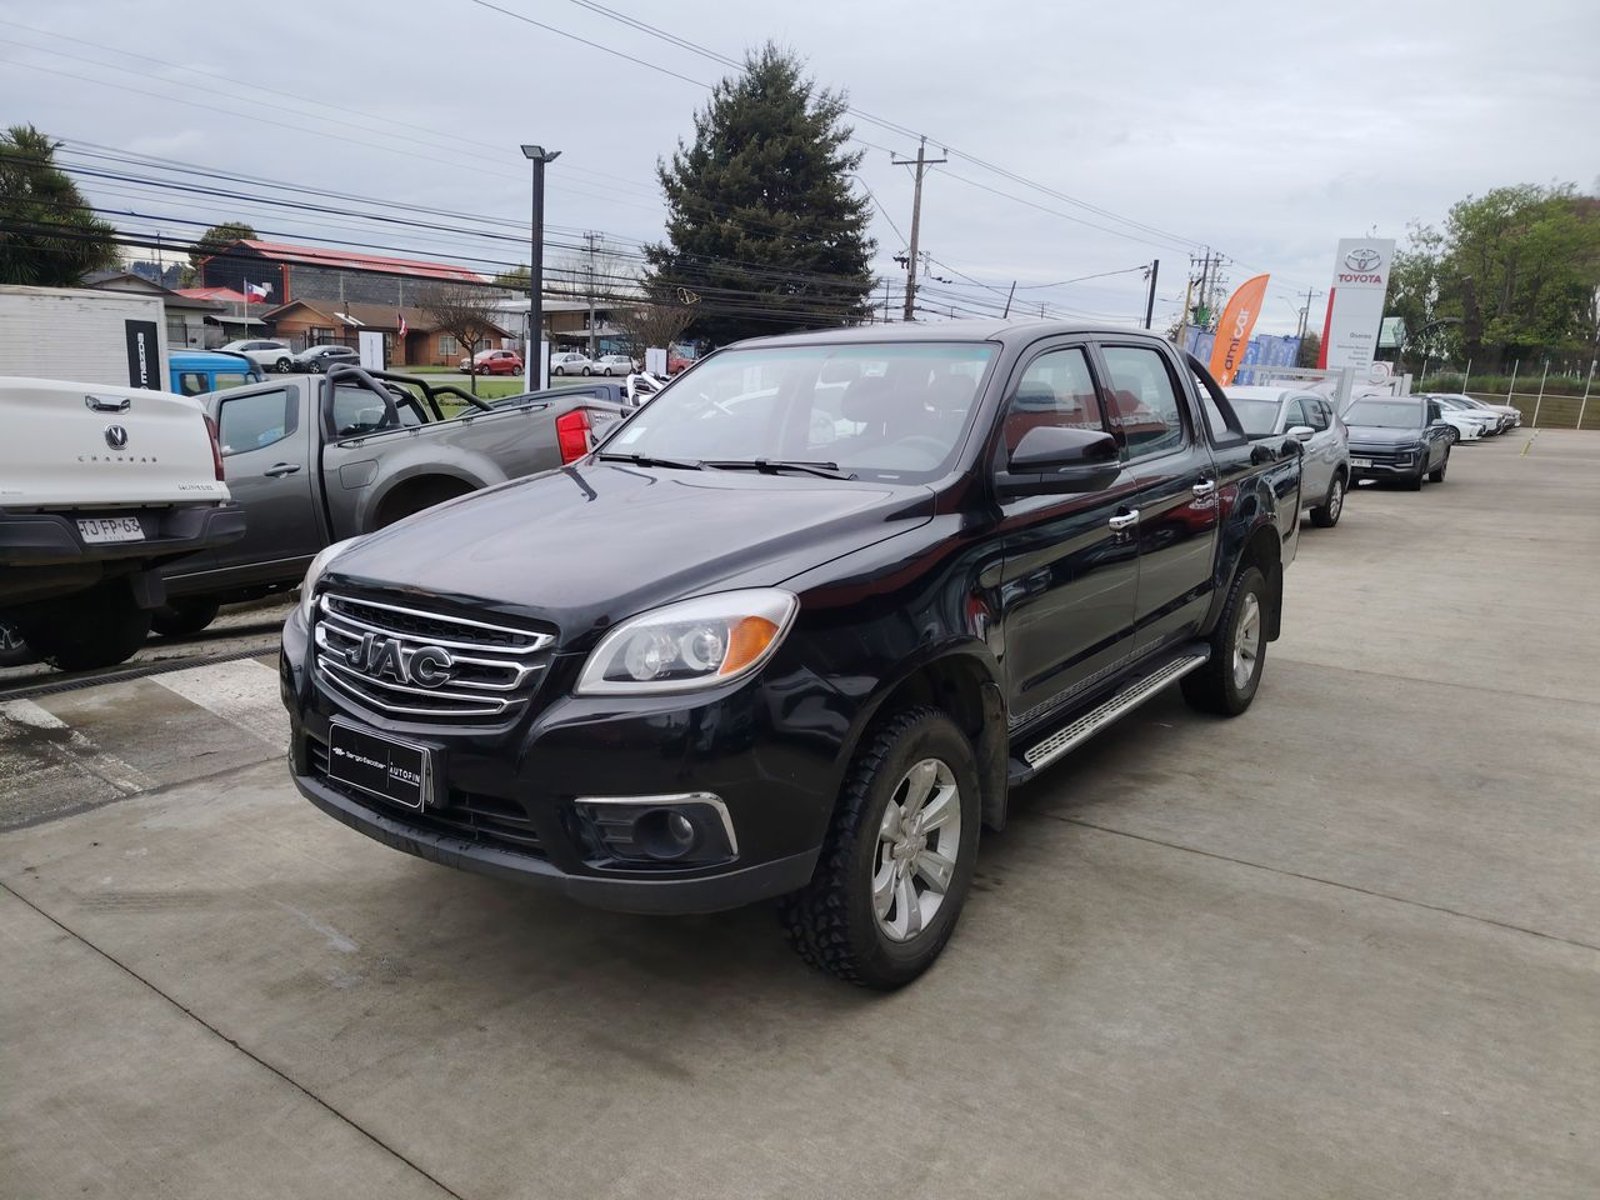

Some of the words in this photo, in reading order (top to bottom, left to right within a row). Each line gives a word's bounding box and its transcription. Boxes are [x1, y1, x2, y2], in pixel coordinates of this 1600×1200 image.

[1338, 274, 1382, 284] TOYOTA
[1225, 308, 1250, 370] amicar
[345, 632, 453, 687] JAC
[390, 767, 420, 783] AUTOFIN
